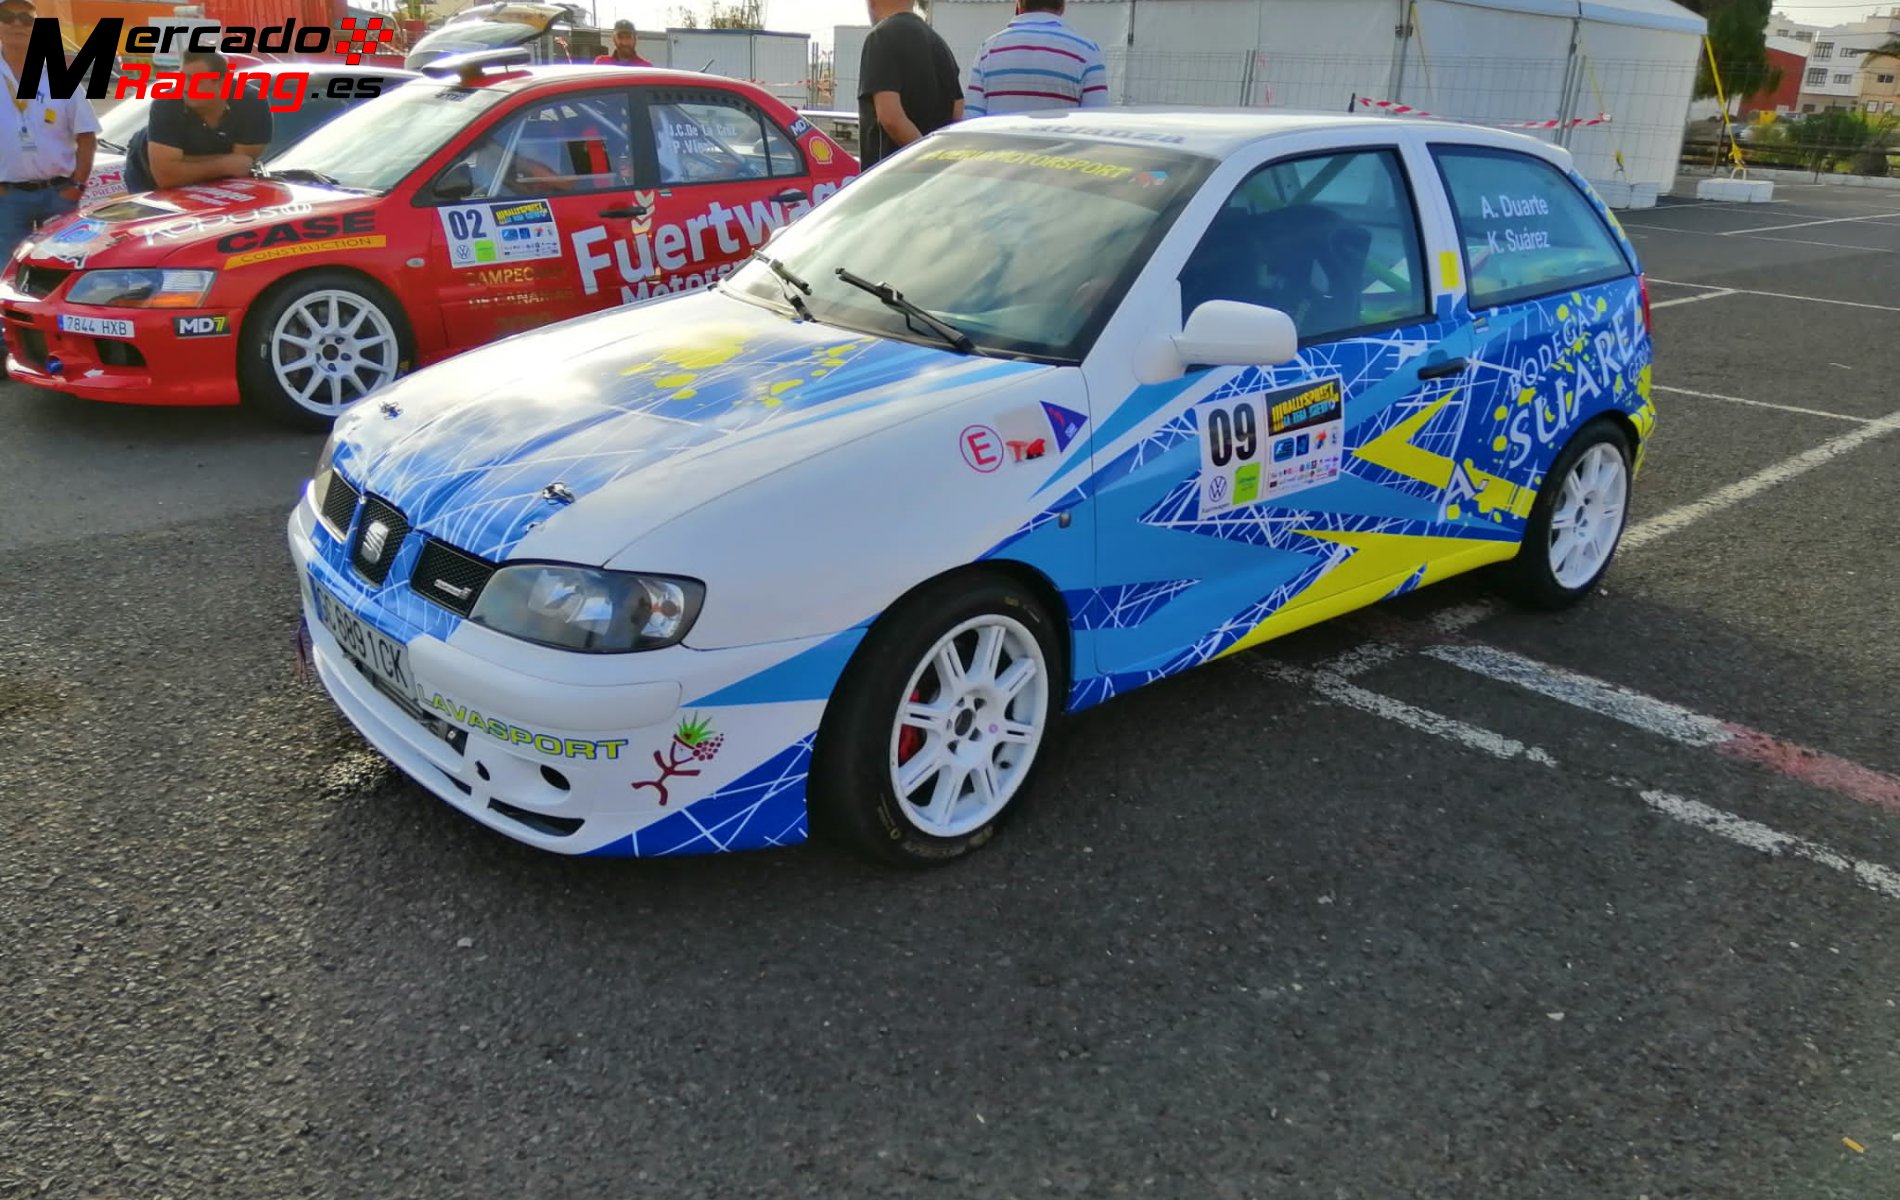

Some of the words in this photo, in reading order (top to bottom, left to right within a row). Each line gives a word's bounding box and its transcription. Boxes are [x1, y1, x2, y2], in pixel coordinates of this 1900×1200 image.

[1481, 195, 1499, 220] A.
[1499, 194, 1549, 219] Duarte
[217, 211, 377, 255] CASE
[448, 209, 487, 241] 02
[240, 238, 372, 264] CONSTRUCTION
[1487, 230, 1503, 255] K.
[1505, 226, 1550, 252] Suárez
[66, 317, 97, 334] 7844
[101, 319, 128, 336] HXB
[178, 316, 227, 334] MD7
[1509, 294, 1599, 402] BODEGAS
[1208, 403, 1257, 467] 09
[417, 683, 629, 760] LAVASPORT
